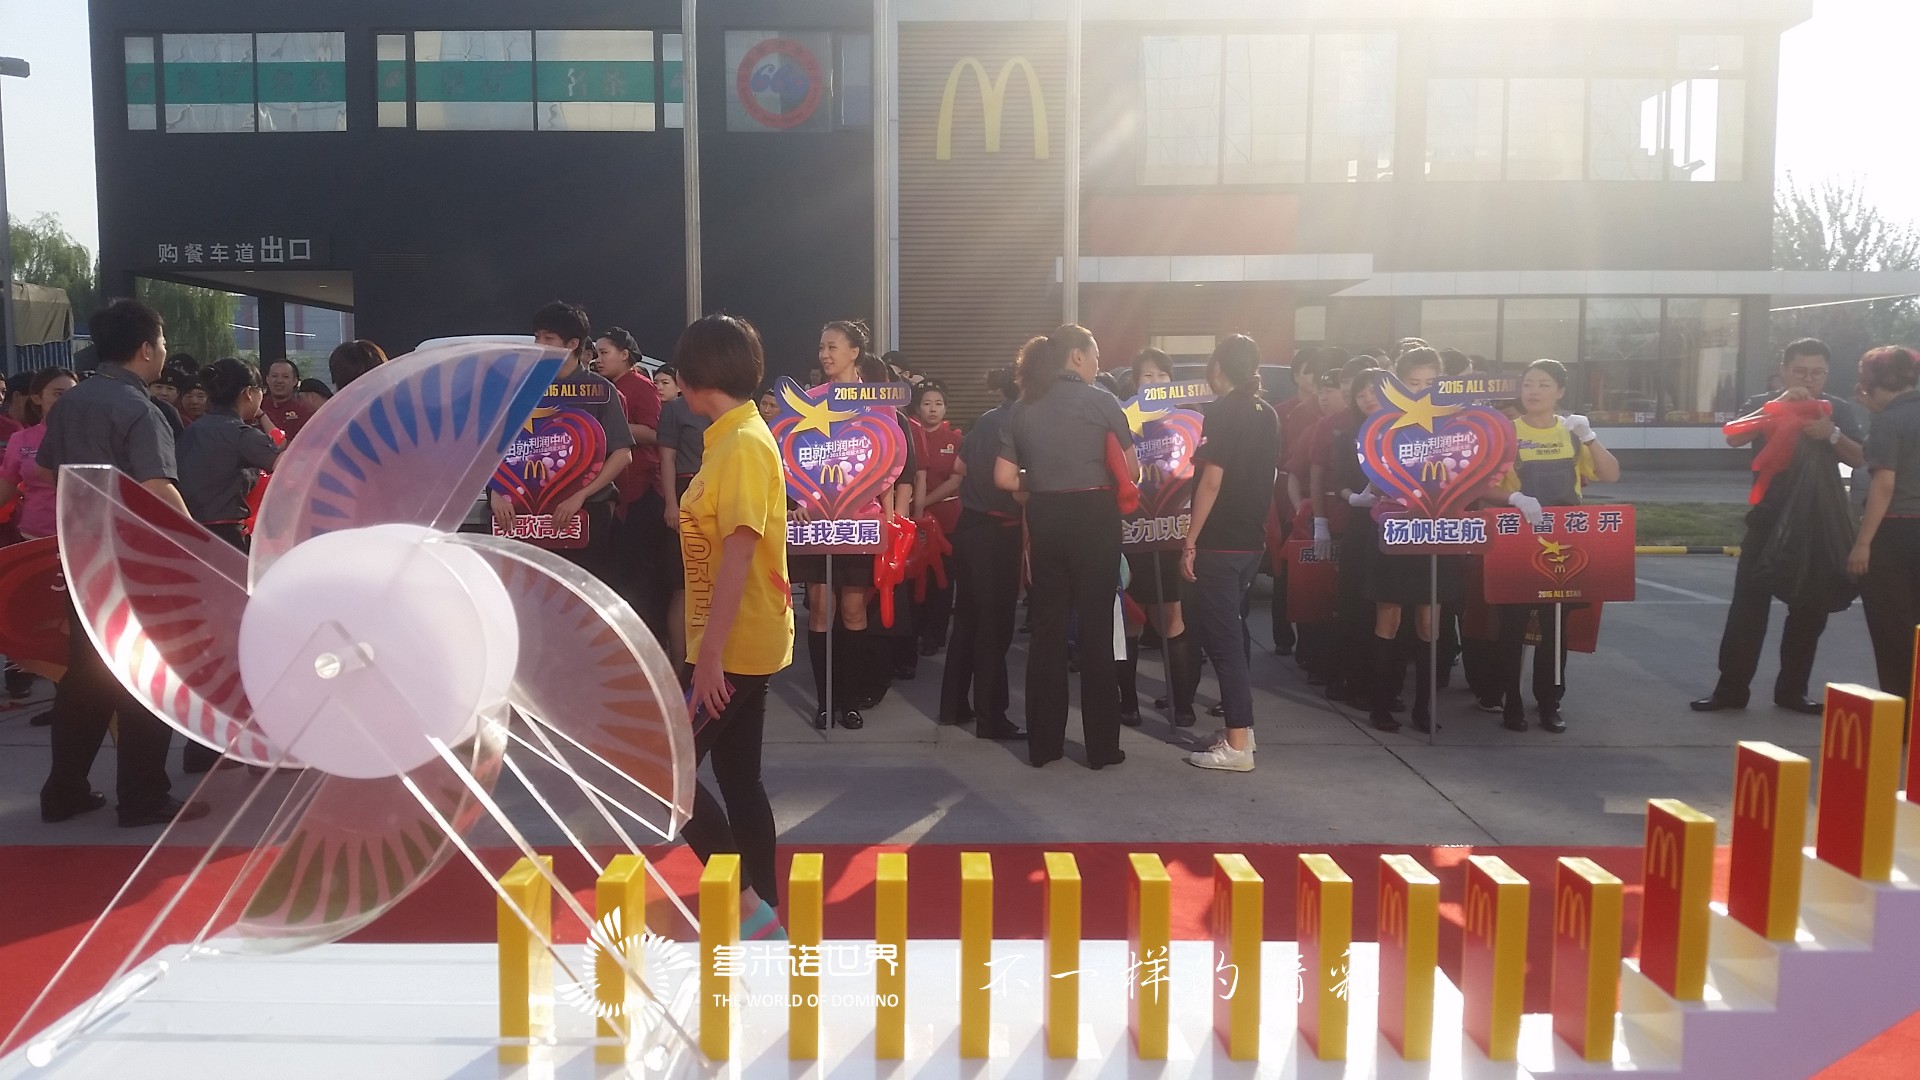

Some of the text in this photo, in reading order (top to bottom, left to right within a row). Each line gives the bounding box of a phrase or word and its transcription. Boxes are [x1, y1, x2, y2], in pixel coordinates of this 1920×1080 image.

[158, 236, 310, 263] 购餐车道出口
[561, 384, 577, 397] ALL
[580, 384, 604, 397] STAR
[834, 386, 905, 400] 2015 ALL STAR
[1144, 388, 1167, 401] 2015
[1169, 385, 1186, 399] ALL
[1438, 379, 1516, 394] 2015 ALL STAR
[1497, 511, 1623, 535] 蓓蕾花开
[787, 519, 879, 545] 菲我莫属
[1385, 519, 1486, 545] 杨帆起航
[1553, 590, 1564, 598] ALL
